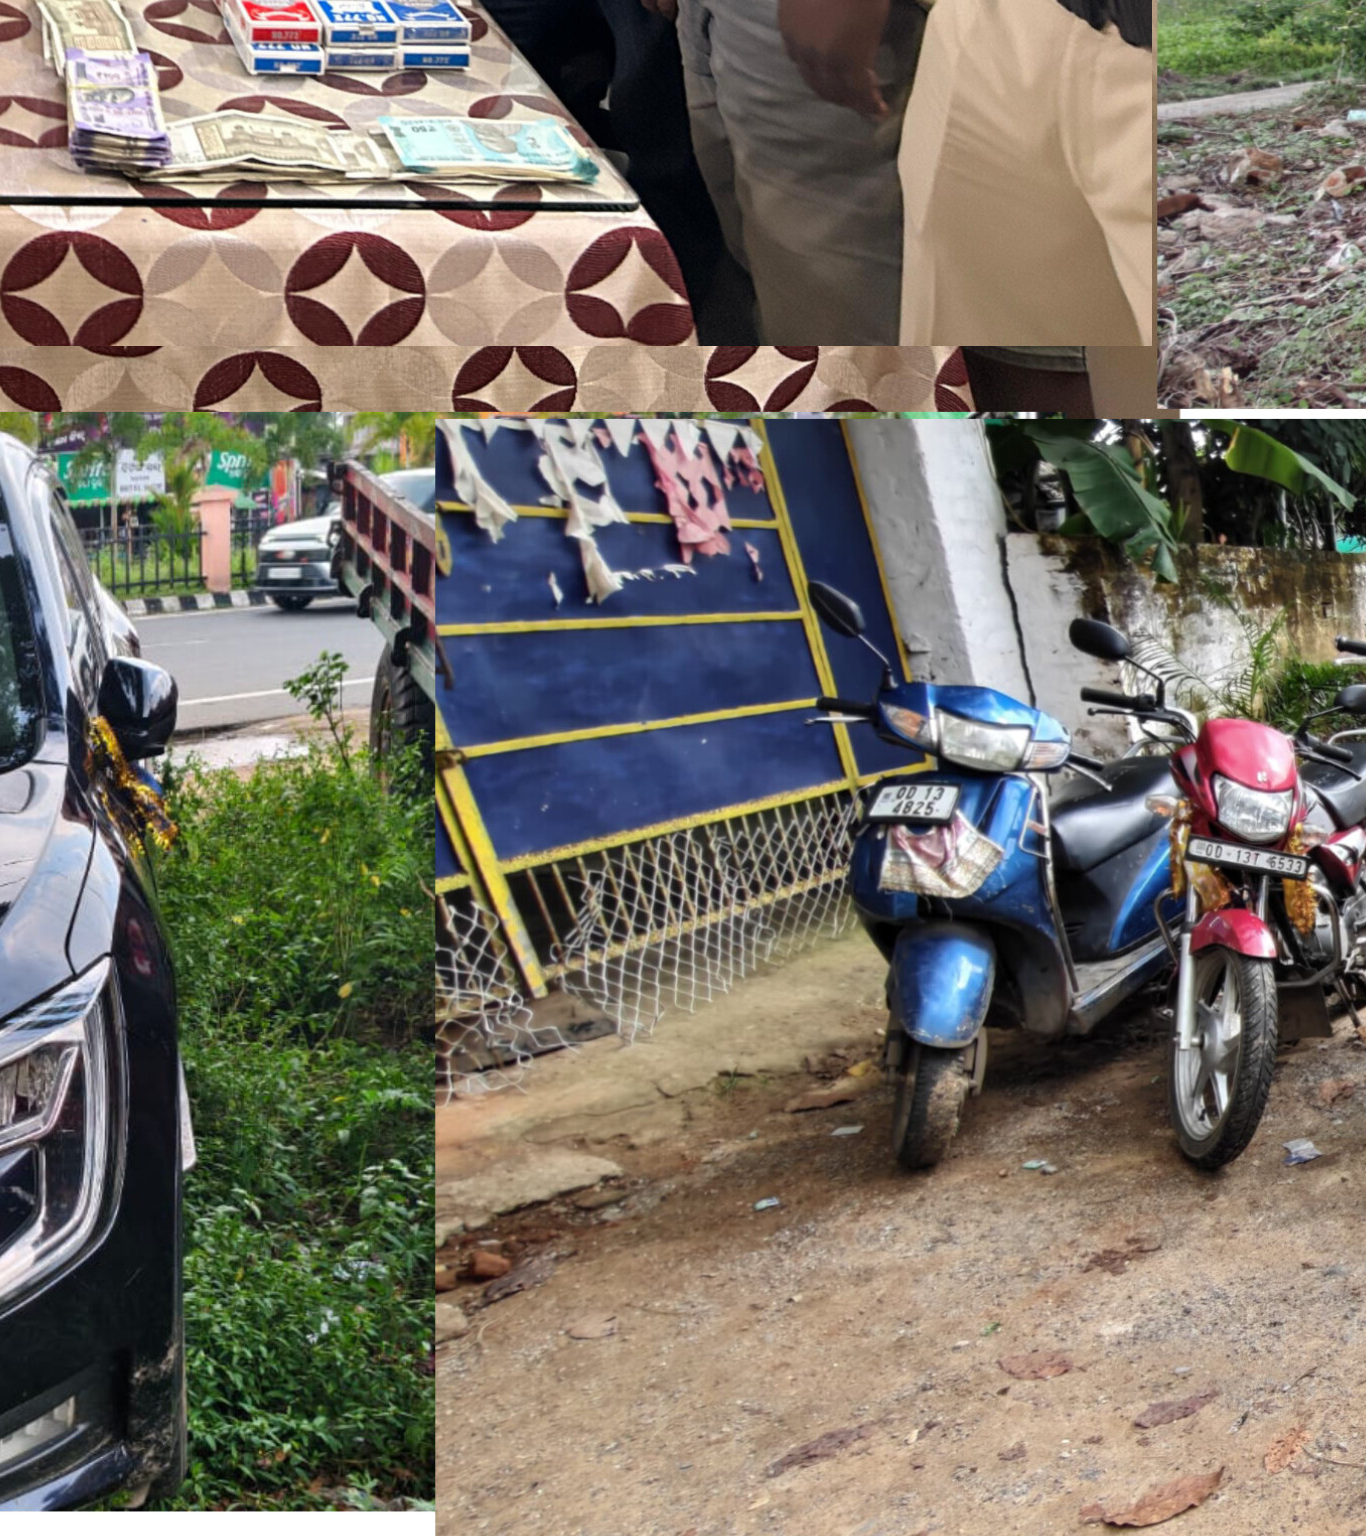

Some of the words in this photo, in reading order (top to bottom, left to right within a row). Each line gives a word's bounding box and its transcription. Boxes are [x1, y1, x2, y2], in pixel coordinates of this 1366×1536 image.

[896, 786, 917, 800] OD
[925, 786, 945, 801] 13
[892, 800, 934, 816] 4825
[1205, 843, 1223, 858] OD
